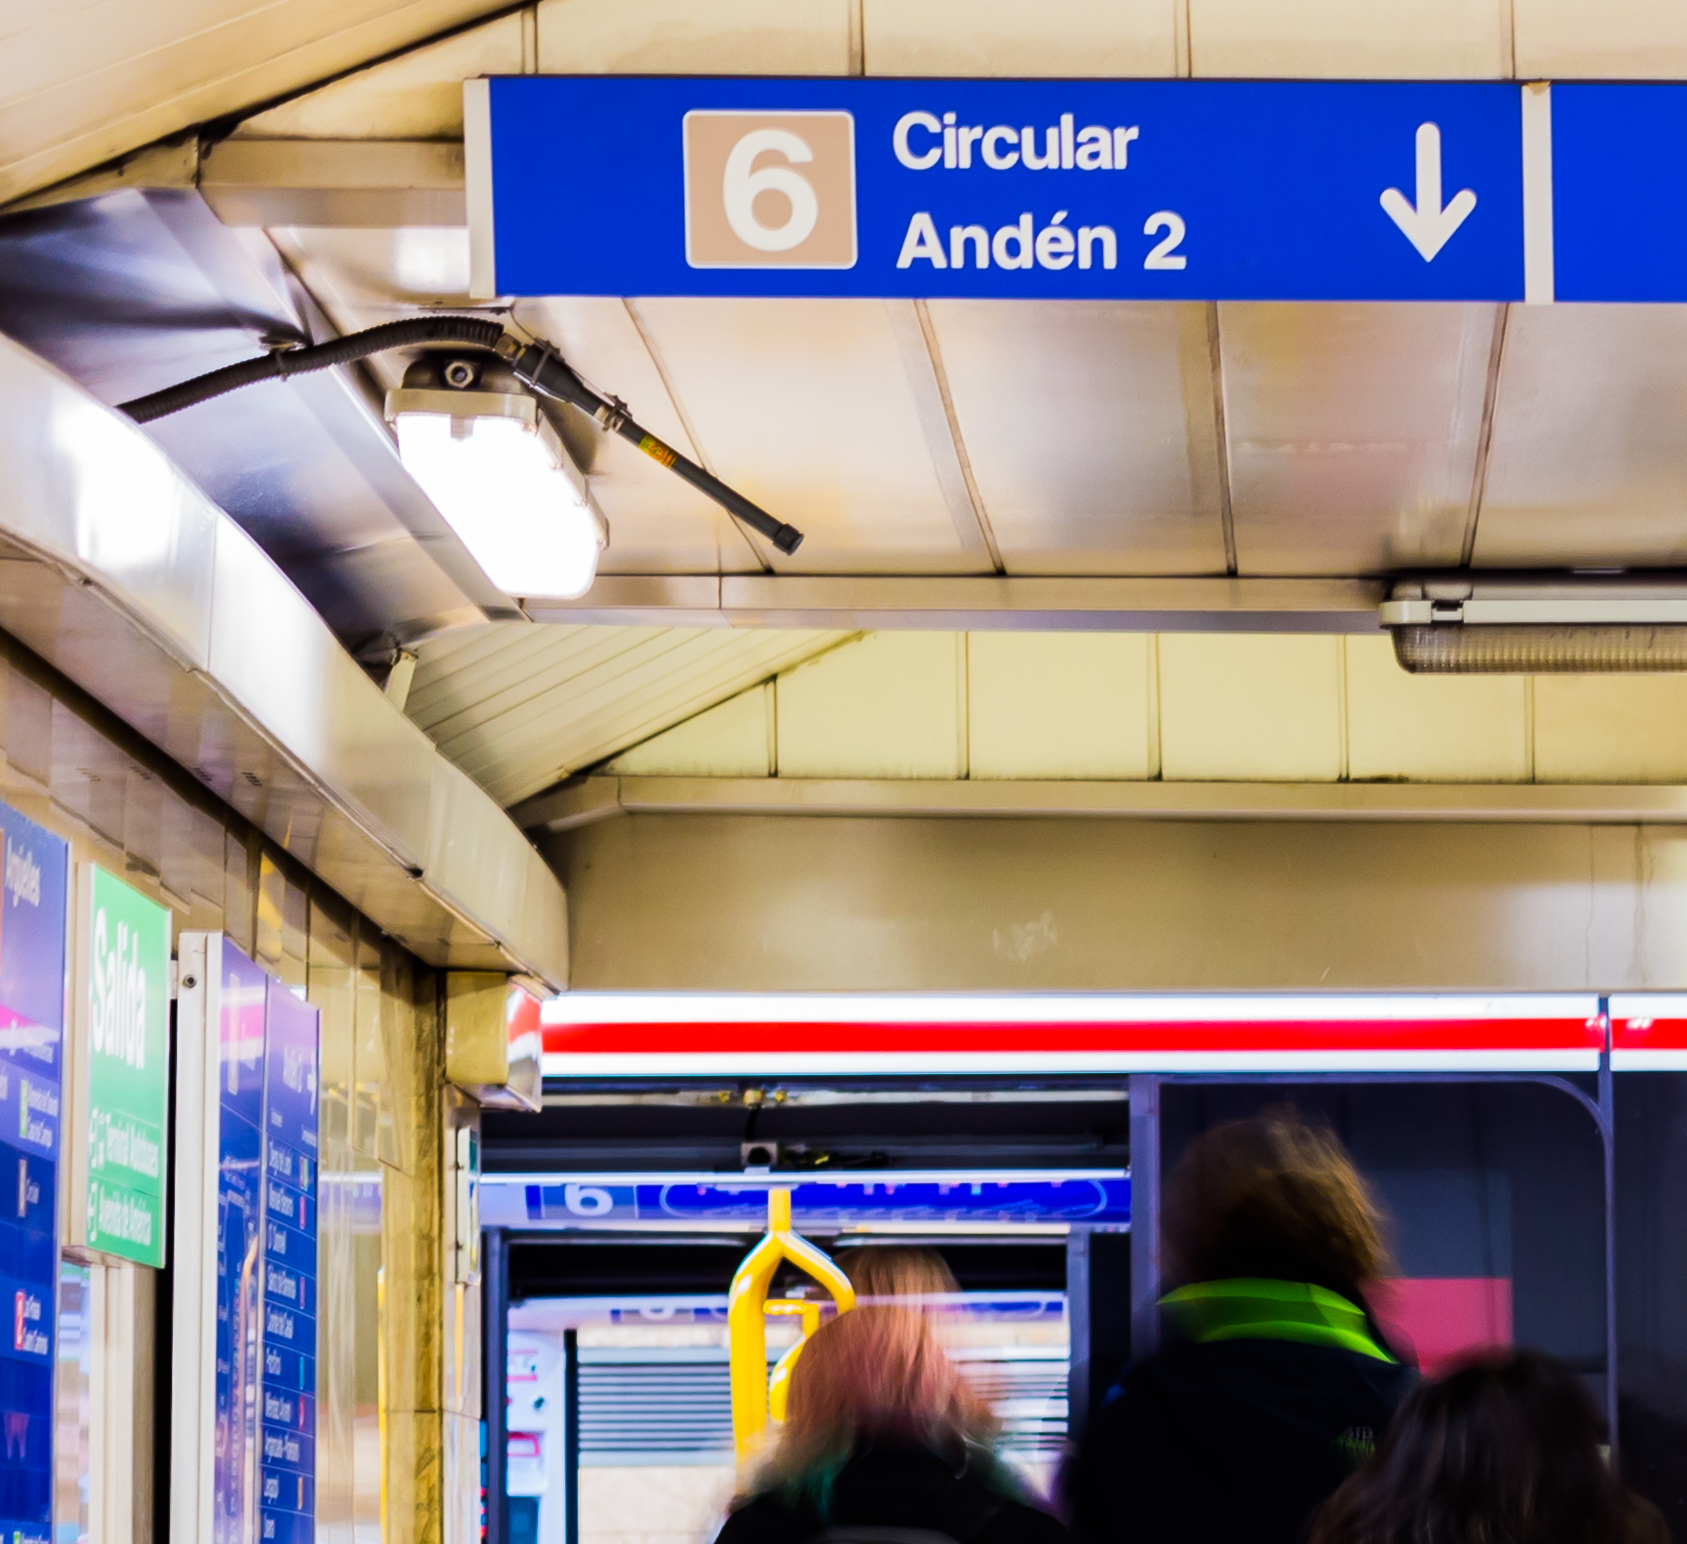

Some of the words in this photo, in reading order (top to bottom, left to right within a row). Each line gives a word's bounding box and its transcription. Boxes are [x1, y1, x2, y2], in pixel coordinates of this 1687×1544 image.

[893, 111, 1139, 170] Circular
[722, 130, 819, 251] 6
[896, 211, 1117, 270] Andén
[1144, 211, 1186, 270] 2
[92, 905, 146, 1070] Salida
